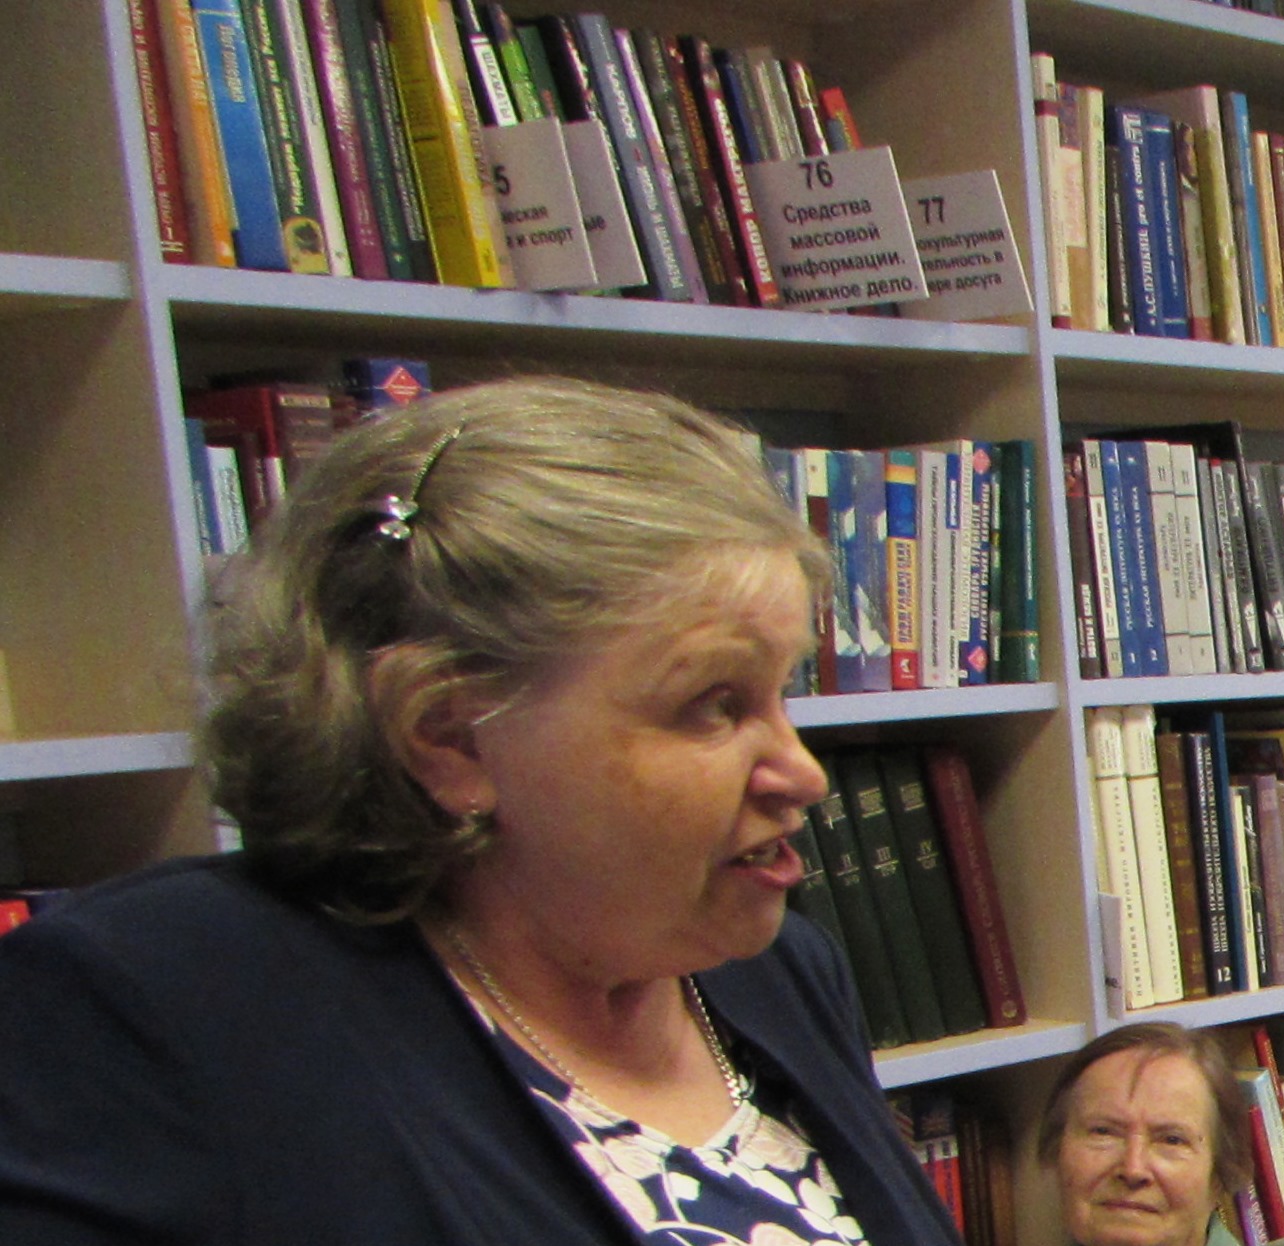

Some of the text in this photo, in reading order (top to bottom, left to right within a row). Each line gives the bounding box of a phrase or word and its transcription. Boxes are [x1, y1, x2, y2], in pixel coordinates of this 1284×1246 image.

[799, 161, 834, 190] 76
[783, 198, 872, 225] Средства
[918, 196, 944, 223] 77
[790, 222, 881, 249] массовой
[783, 282, 861, 305] Книжное
[1115, 527, 1128, 587] ЛИТЕРАТУРА
[1135, 527, 1147, 586] ЛИТЕРАТУРА
[1122, 587, 1133, 631] РУССКАЯ
[1142, 587, 1153, 628] РУССКАЯ
[1217, 966, 1232, 983] 12
